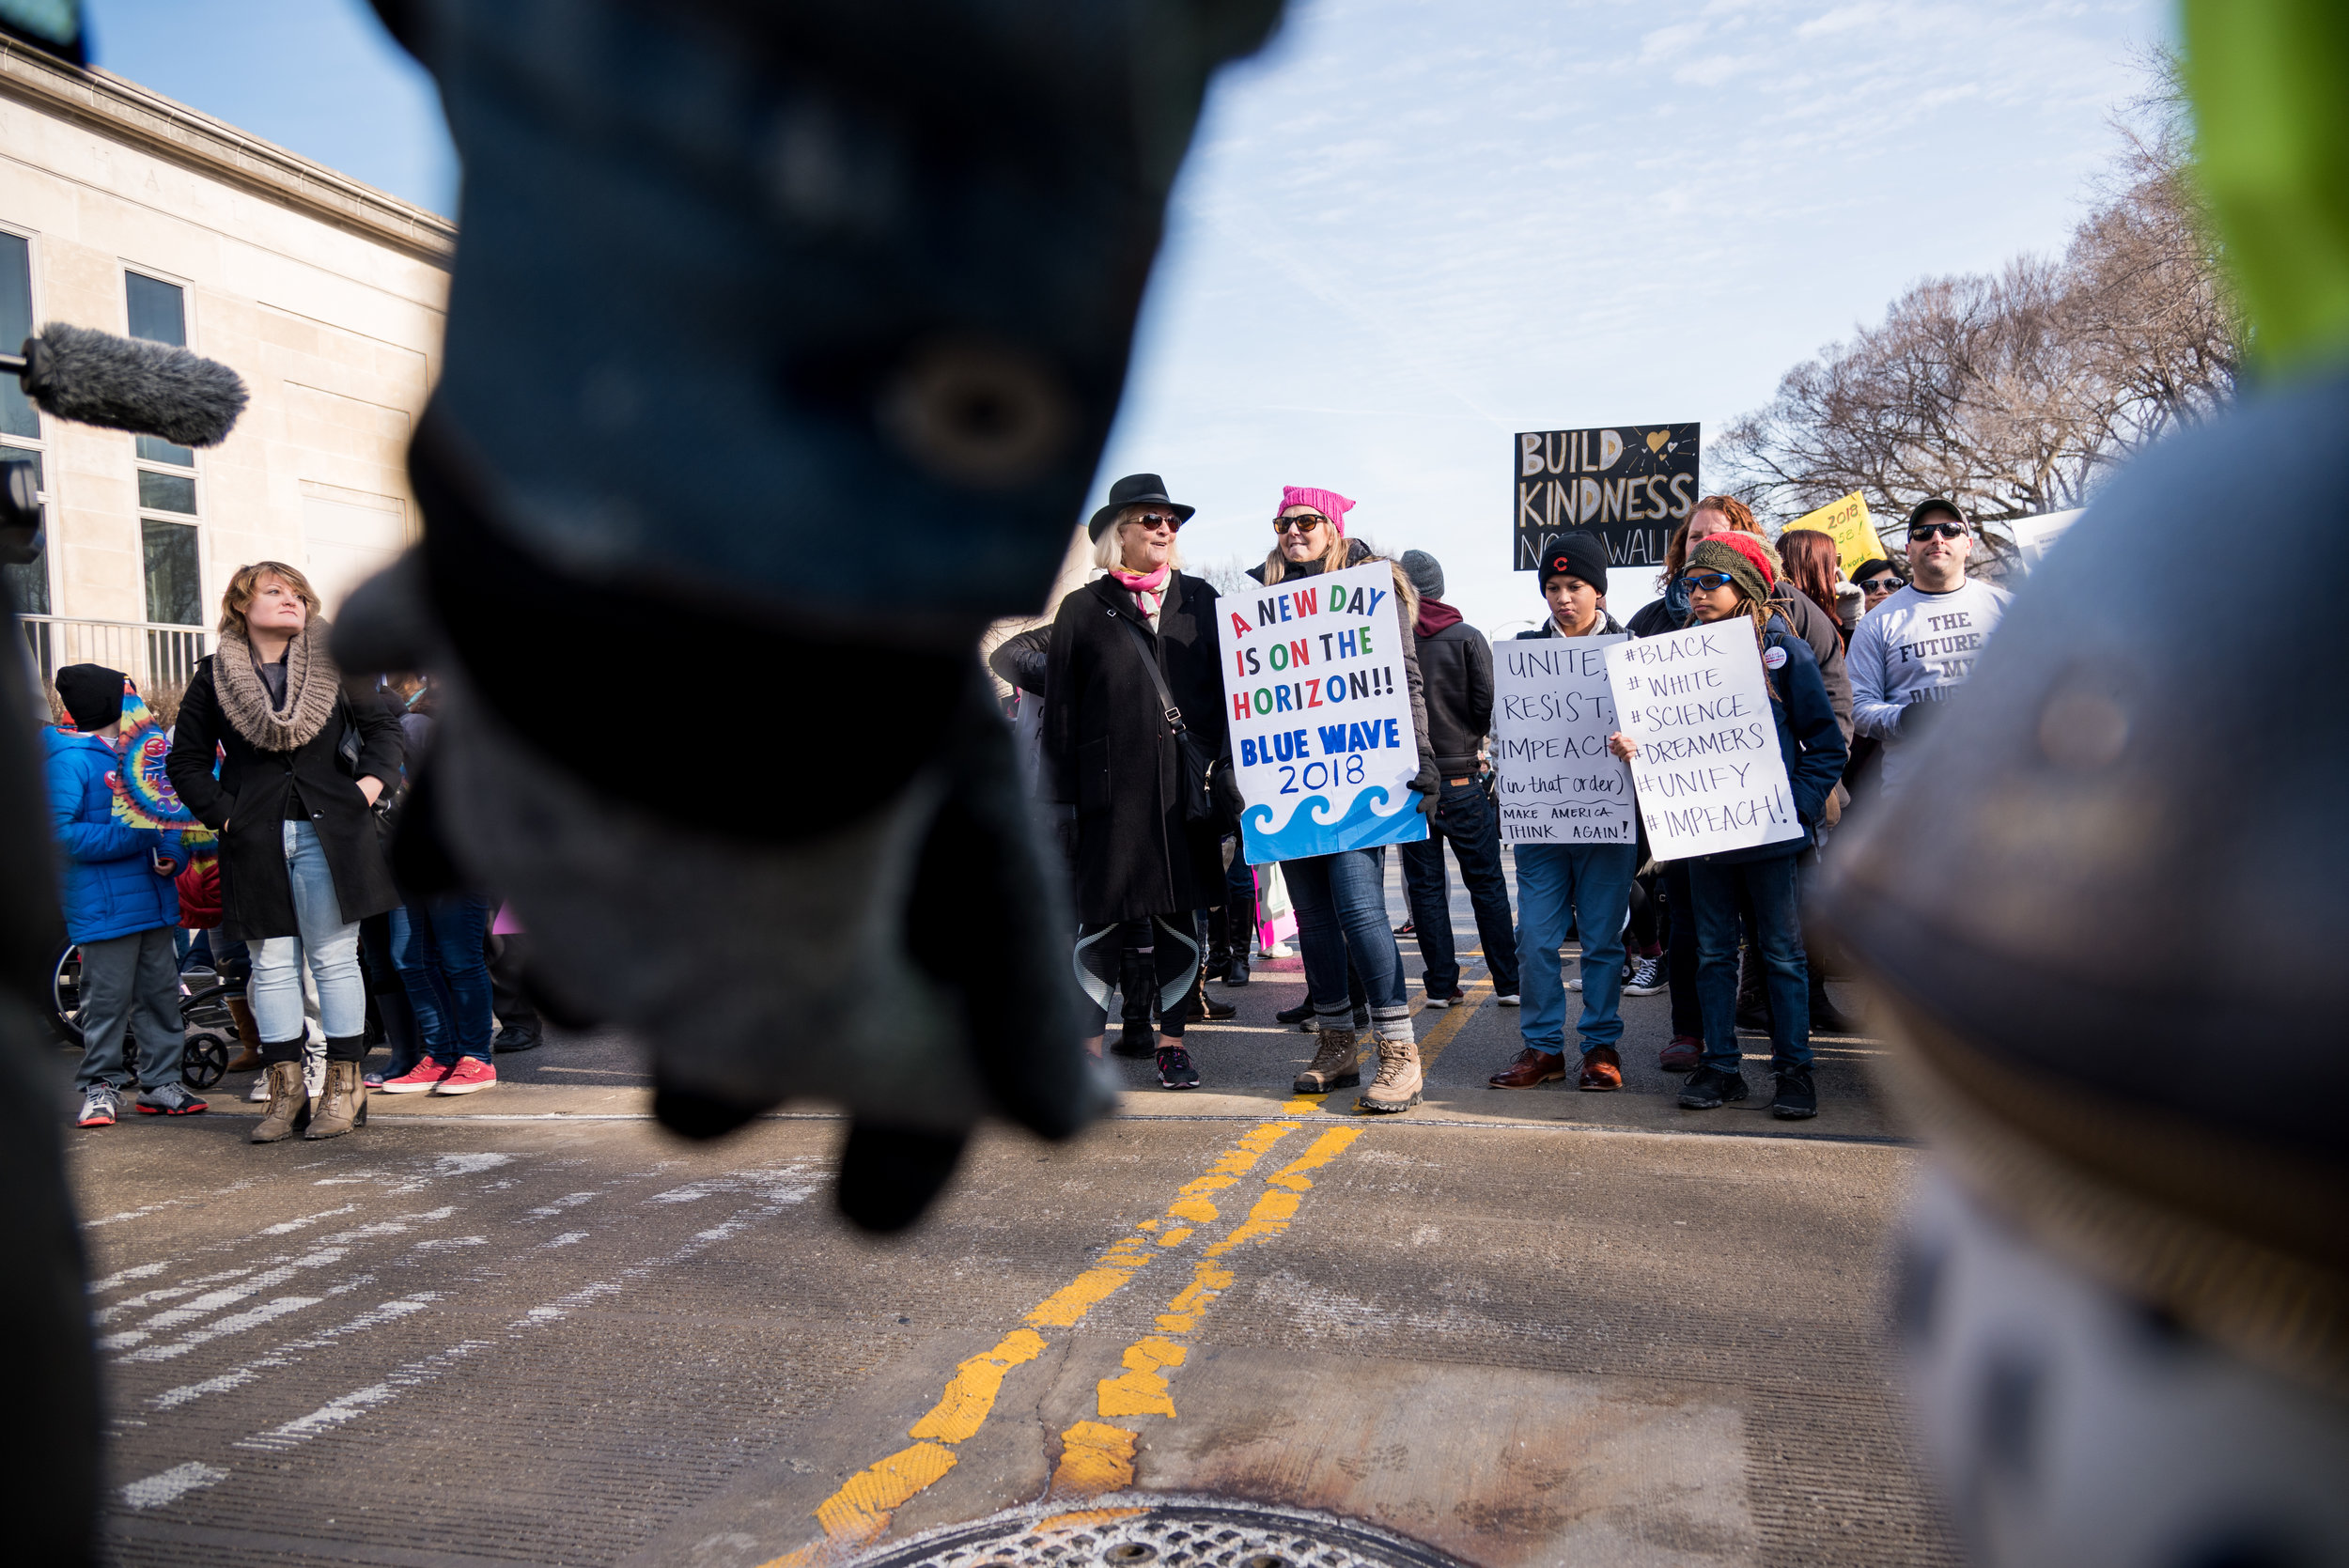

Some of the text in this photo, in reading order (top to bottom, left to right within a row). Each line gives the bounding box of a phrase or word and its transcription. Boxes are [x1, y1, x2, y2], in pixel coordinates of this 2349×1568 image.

[1521, 429, 1624, 476] BUILD
[1519, 473, 1694, 527] KINDNESS
[1827, 504, 1859, 530] 2018
[1231, 584, 1386, 639] A NEW DAY
[1927, 612, 1972, 632] THE
[1236, 626, 1373, 676] IS ON THE
[1625, 634, 1728, 666] #BLACK
[1899, 632, 1983, 663] FUTURE
[1508, 648, 1608, 681] UNITE;
[1233, 666, 1393, 721] HORIZON!!
[1240, 718, 1400, 767] BLUE WAVE
[1279, 754, 1365, 794] 2018
[1500, 769, 1624, 795] (in that order)
[1503, 806, 1614, 819] MAKE AMERICA
[1502, 820, 1628, 839] THINK AGAIN!
